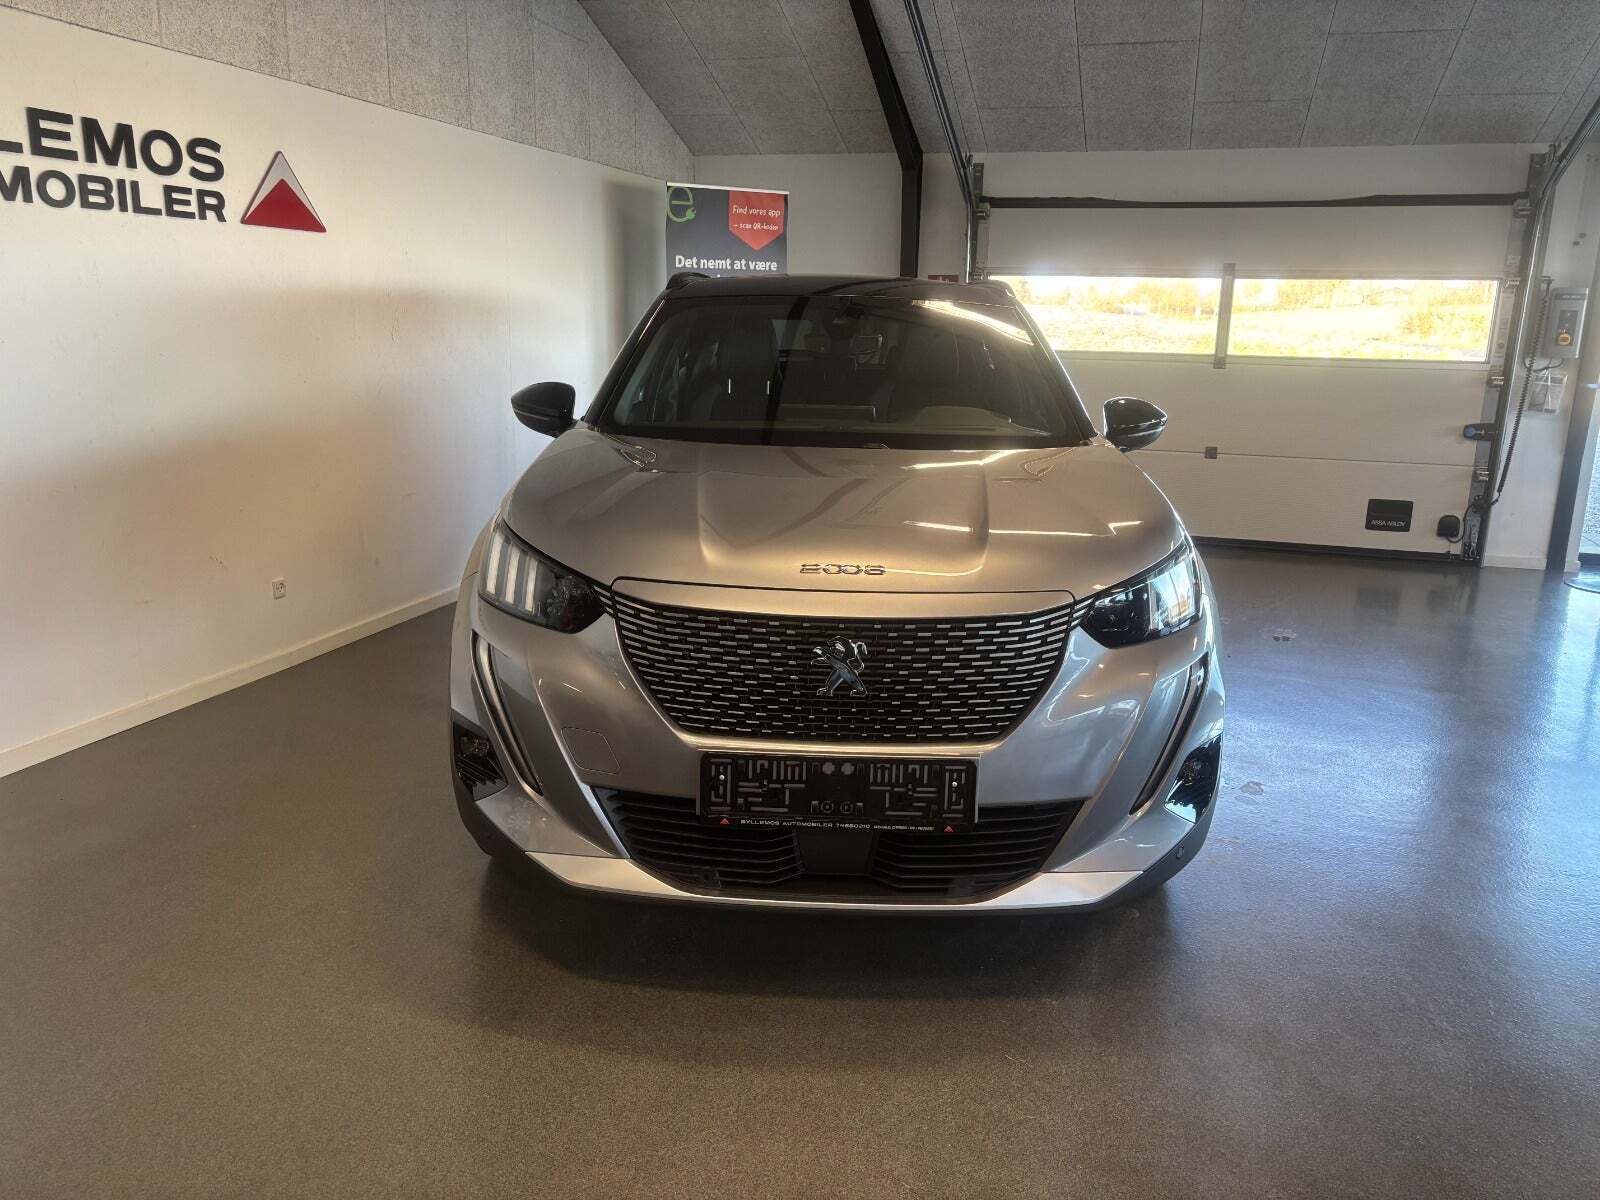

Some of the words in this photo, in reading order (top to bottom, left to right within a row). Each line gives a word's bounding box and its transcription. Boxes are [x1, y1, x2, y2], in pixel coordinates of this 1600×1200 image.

[732, 204, 748, 215] Find
[748, 208, 767, 216] vores
[768, 208, 781, 218] app
[675, 255, 698, 268] Det
[700, 258, 732, 269] nemt
[733, 259, 747, 269] at
[748, 261, 778, 271] være
